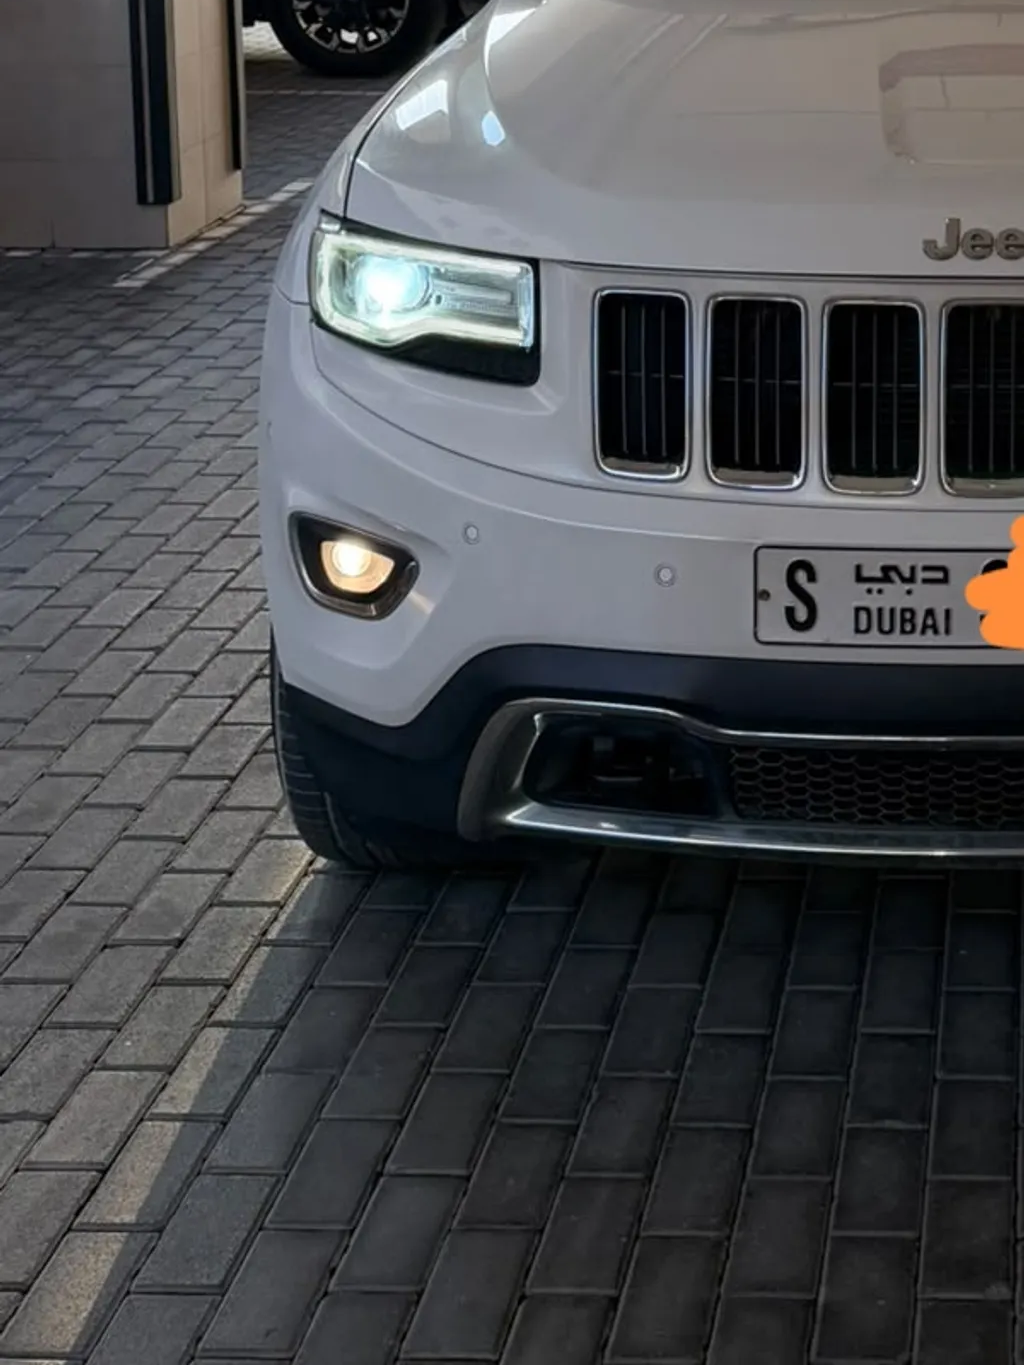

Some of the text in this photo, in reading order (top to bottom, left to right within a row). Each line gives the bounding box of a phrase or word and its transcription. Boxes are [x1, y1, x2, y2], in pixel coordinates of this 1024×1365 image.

[784, 559, 818, 632] S
[854, 564, 949, 596] دبي
[853, 606, 953, 636] DUBAI
